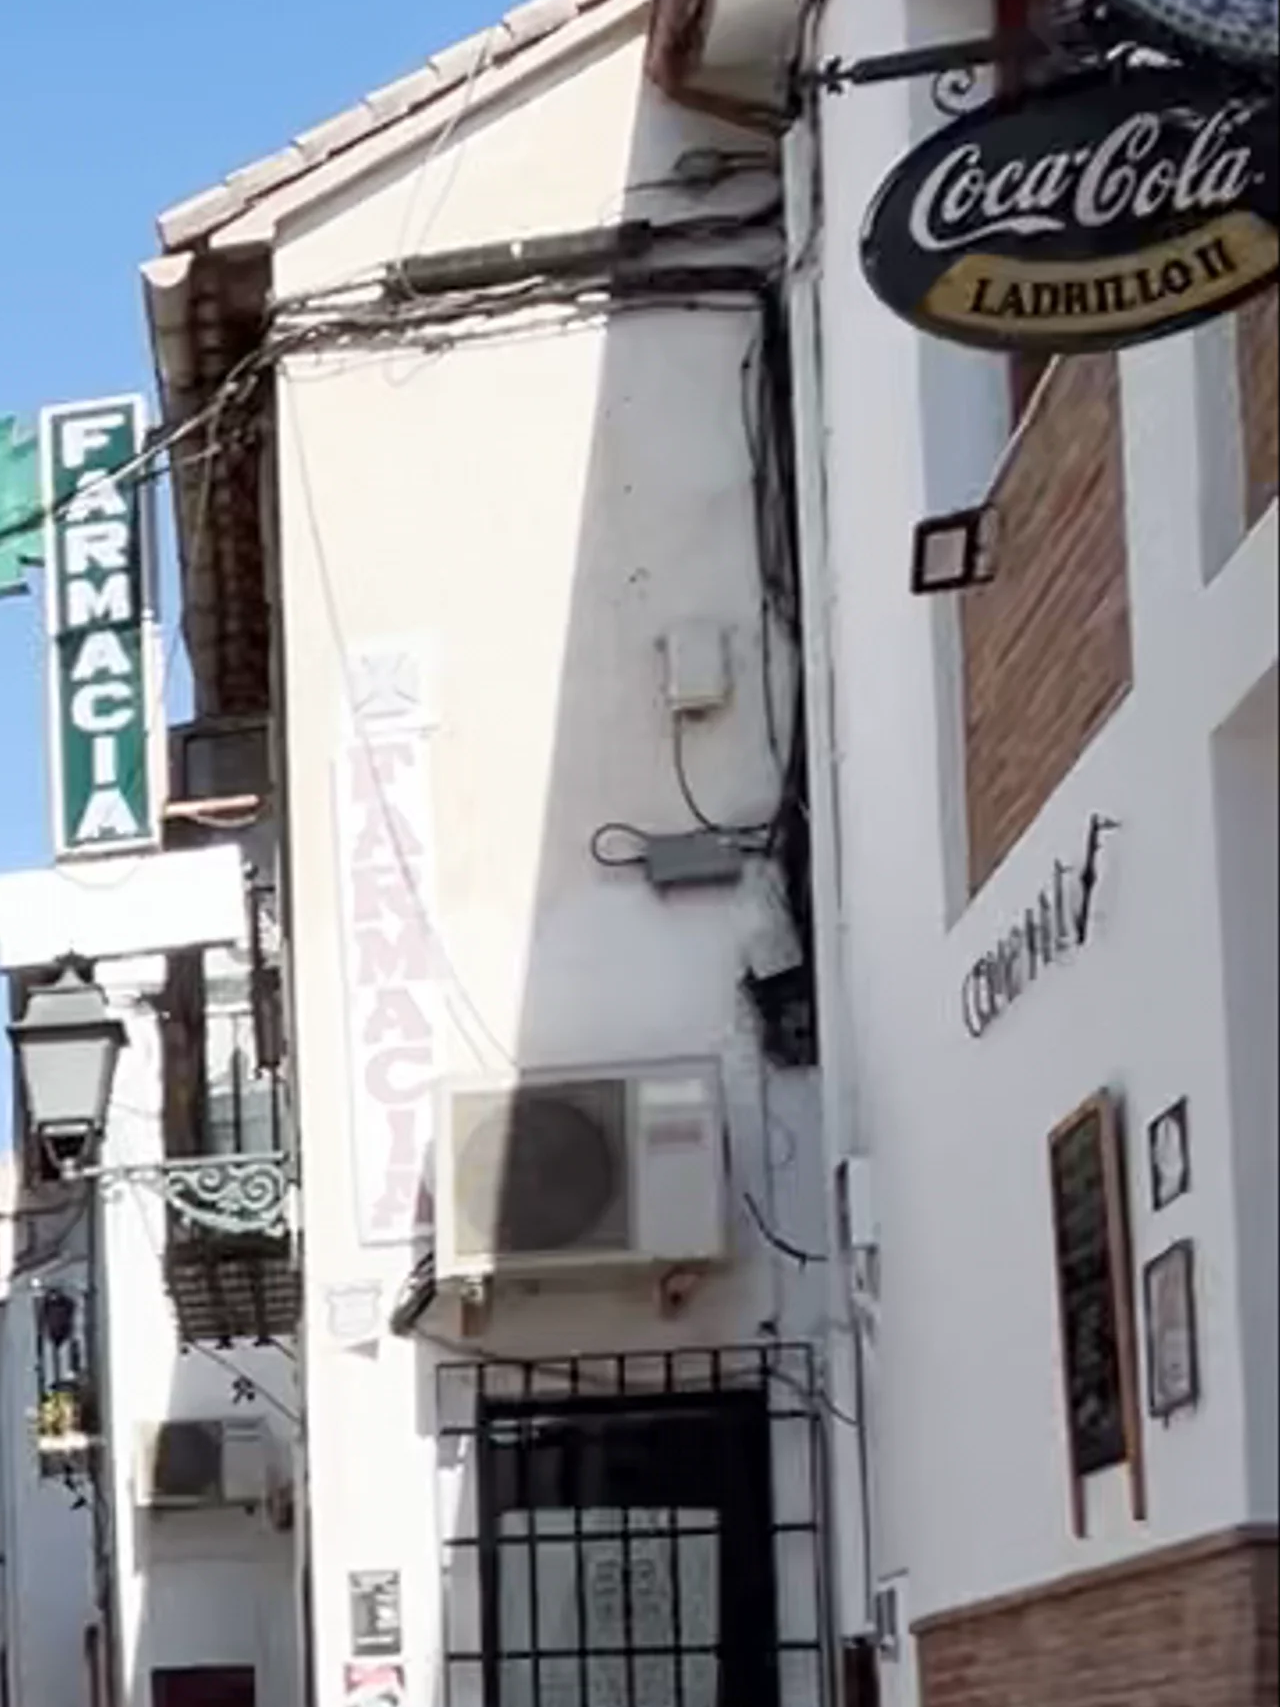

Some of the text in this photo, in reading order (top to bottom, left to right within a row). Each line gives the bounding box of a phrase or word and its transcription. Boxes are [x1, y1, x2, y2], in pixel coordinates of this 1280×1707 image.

[908, 107, 1252, 252] Coca-Cola
[967, 255, 1193, 316] LADRILLO
[58, 411, 139, 842] FARMACIA
[346, 739, 437, 1231] FARMACIA
